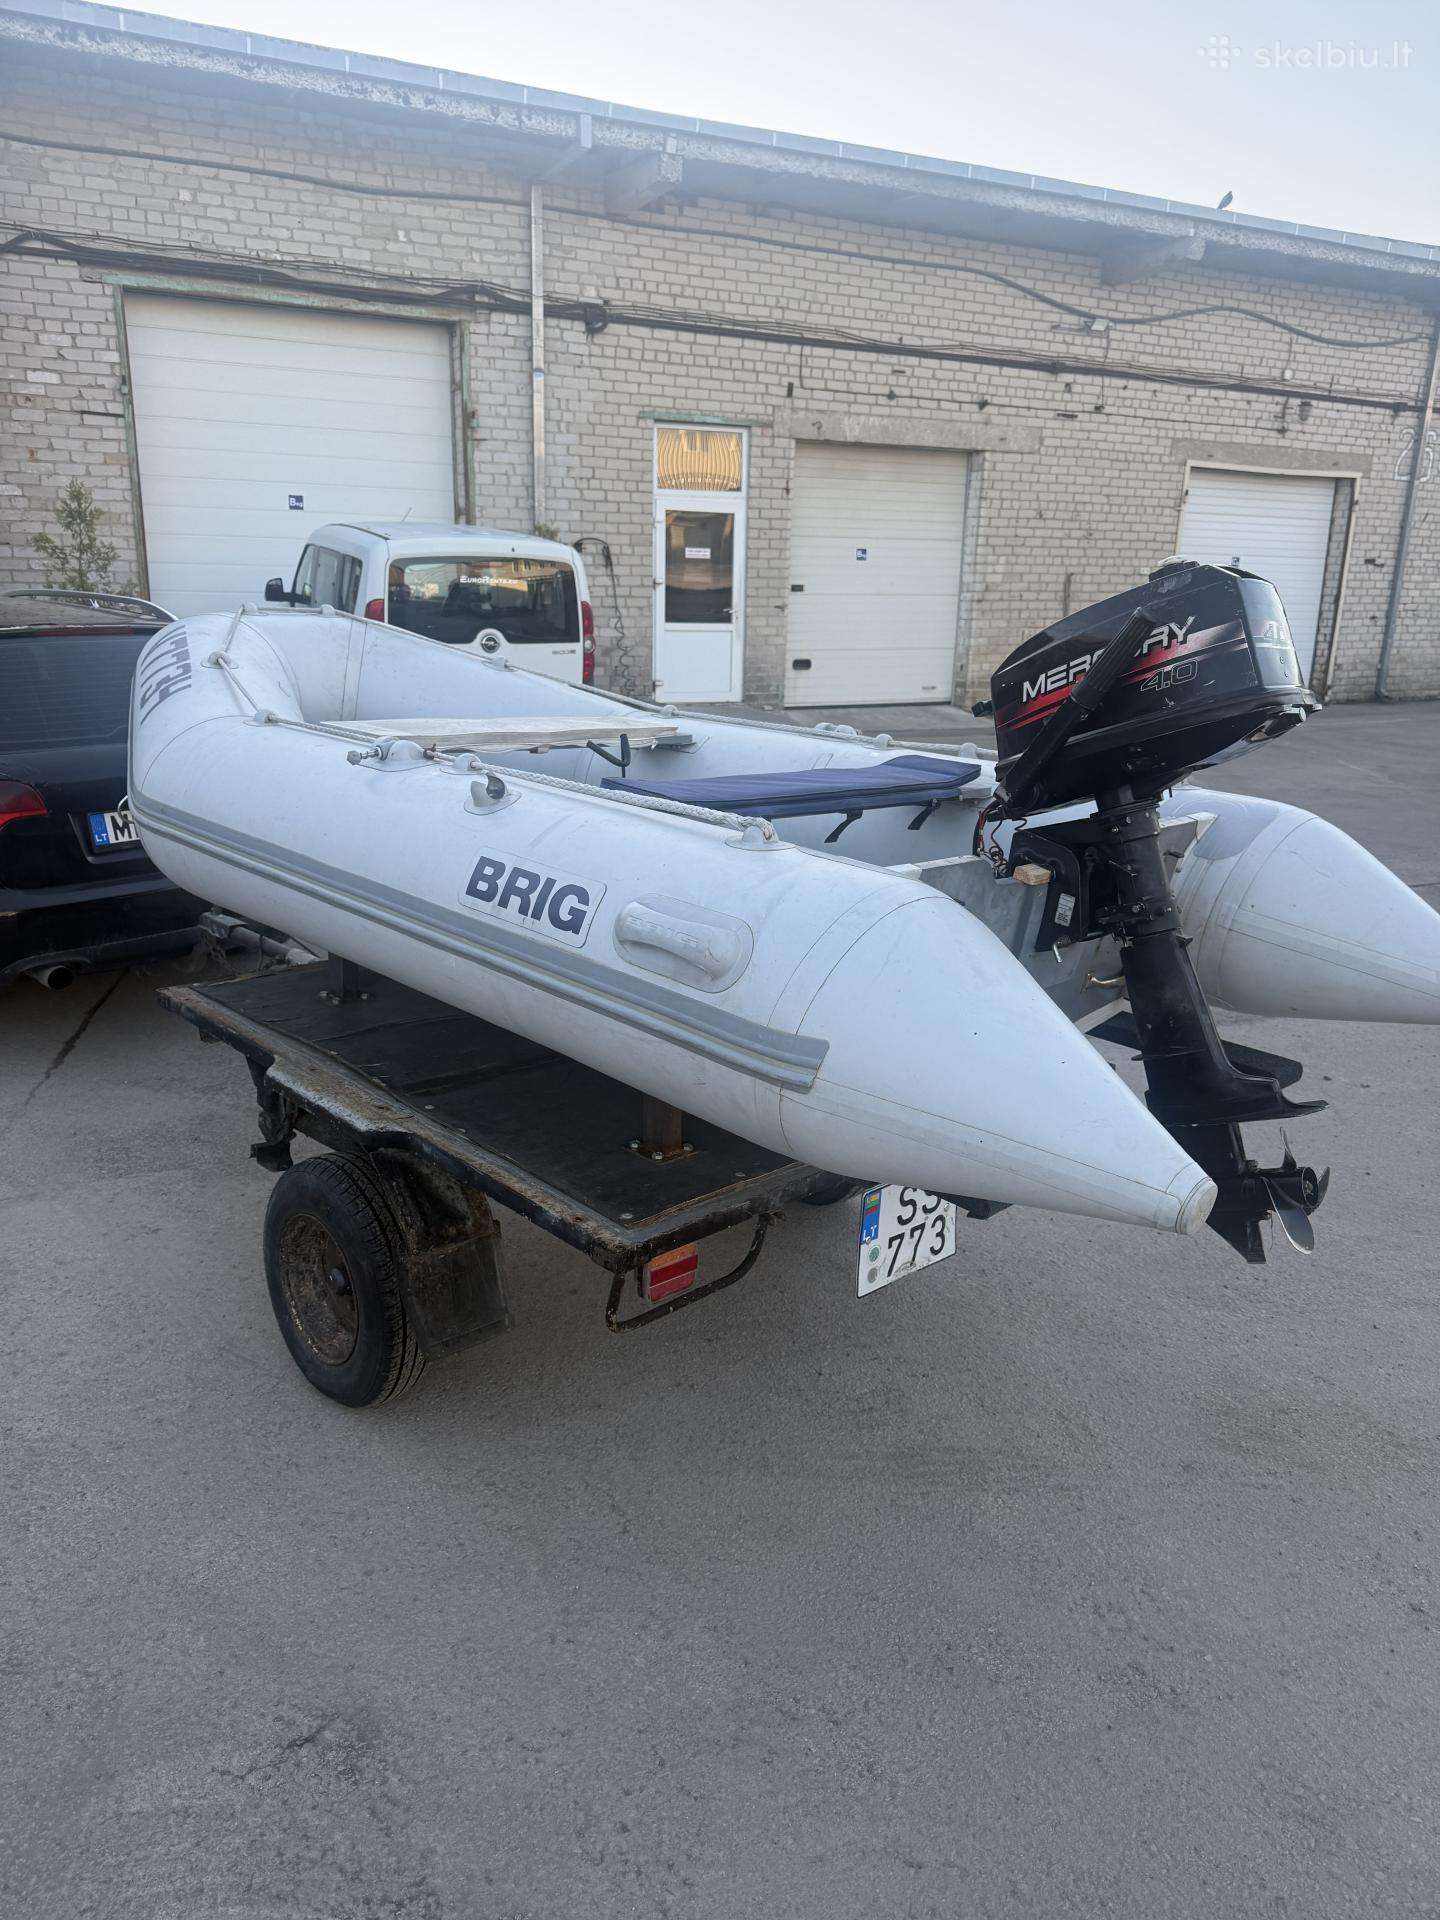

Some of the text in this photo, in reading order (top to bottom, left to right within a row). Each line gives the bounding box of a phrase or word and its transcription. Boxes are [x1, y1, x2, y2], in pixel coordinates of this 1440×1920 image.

[1022, 615, 1196, 702] MERRY
[95, 833, 108, 842] LT
[465, 856, 590, 935] BRIG
[887, 1214, 946, 1278] 773
